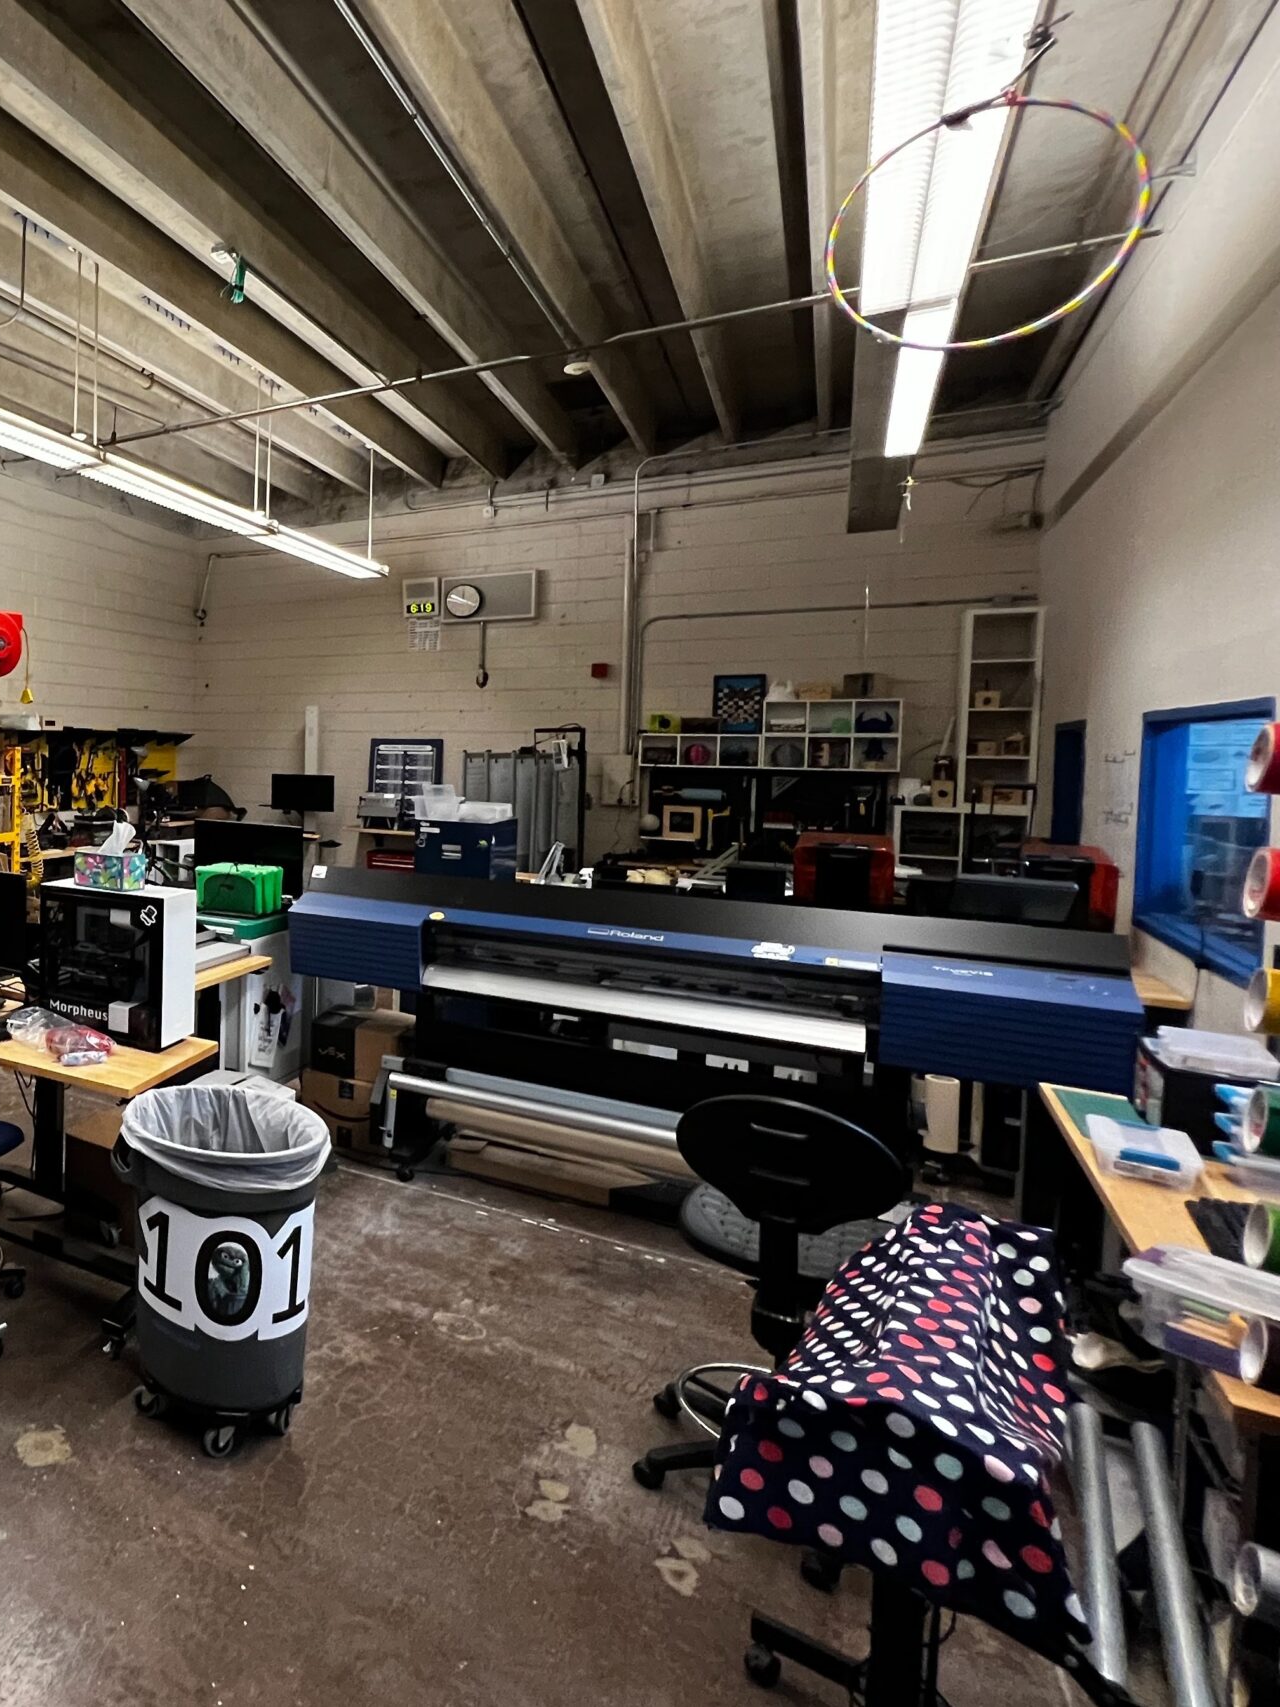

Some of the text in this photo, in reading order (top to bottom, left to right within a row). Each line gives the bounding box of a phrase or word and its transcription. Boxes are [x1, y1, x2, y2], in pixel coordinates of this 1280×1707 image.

[609, 929, 664, 942] Roland
[49, 998, 108, 1021] Morpheus
[144, 1211, 306, 1326] 101
